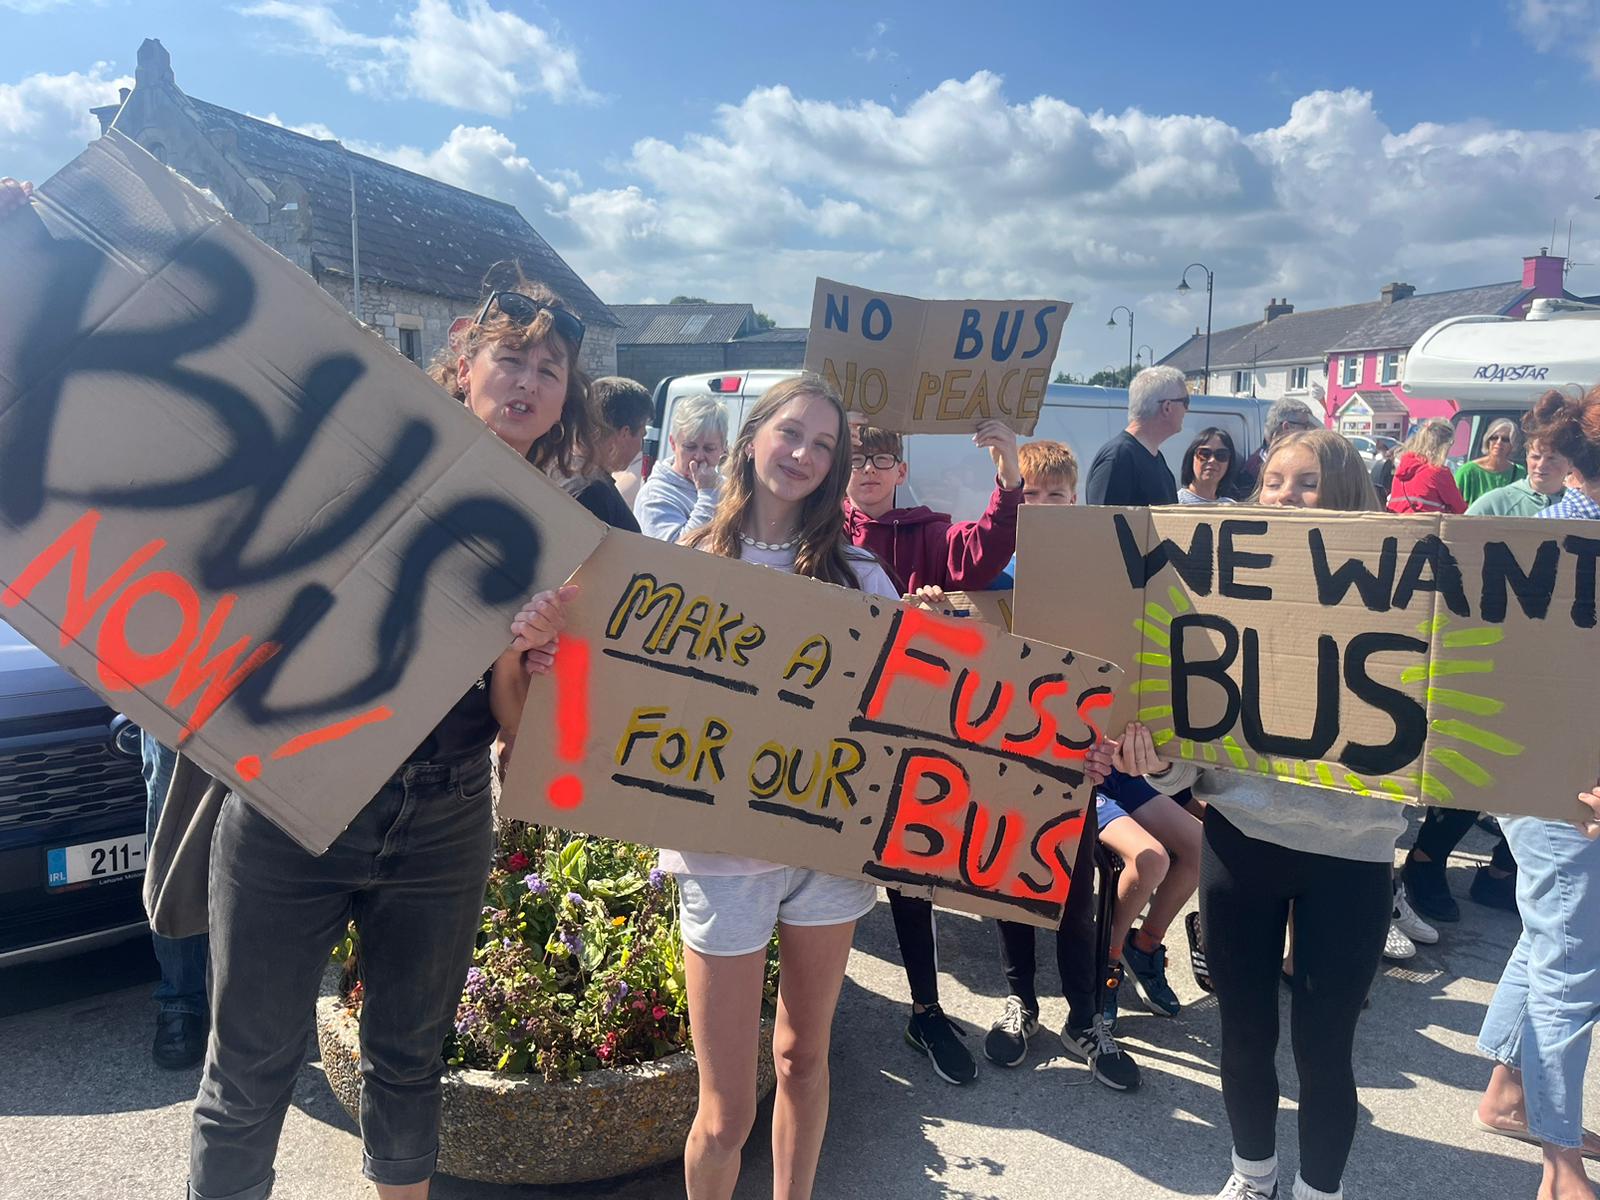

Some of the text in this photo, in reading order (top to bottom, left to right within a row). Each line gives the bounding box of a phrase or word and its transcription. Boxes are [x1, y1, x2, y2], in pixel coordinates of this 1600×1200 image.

[824, 293, 1057, 362] NO BUS
[822, 359, 1050, 421] NO PEACE
[1473, 363, 1549, 382] ROADSTAR
[0, 232, 541, 726] BUS
[1113, 513, 1600, 629] WE WANT
[782, 633, 832, 689] A
[1170, 613, 1430, 776] BUS
[612, 704, 1085, 901] FOR OUR BUS
[49, 871, 66, 883] IRL
[91, 843, 148, 876] 211-
